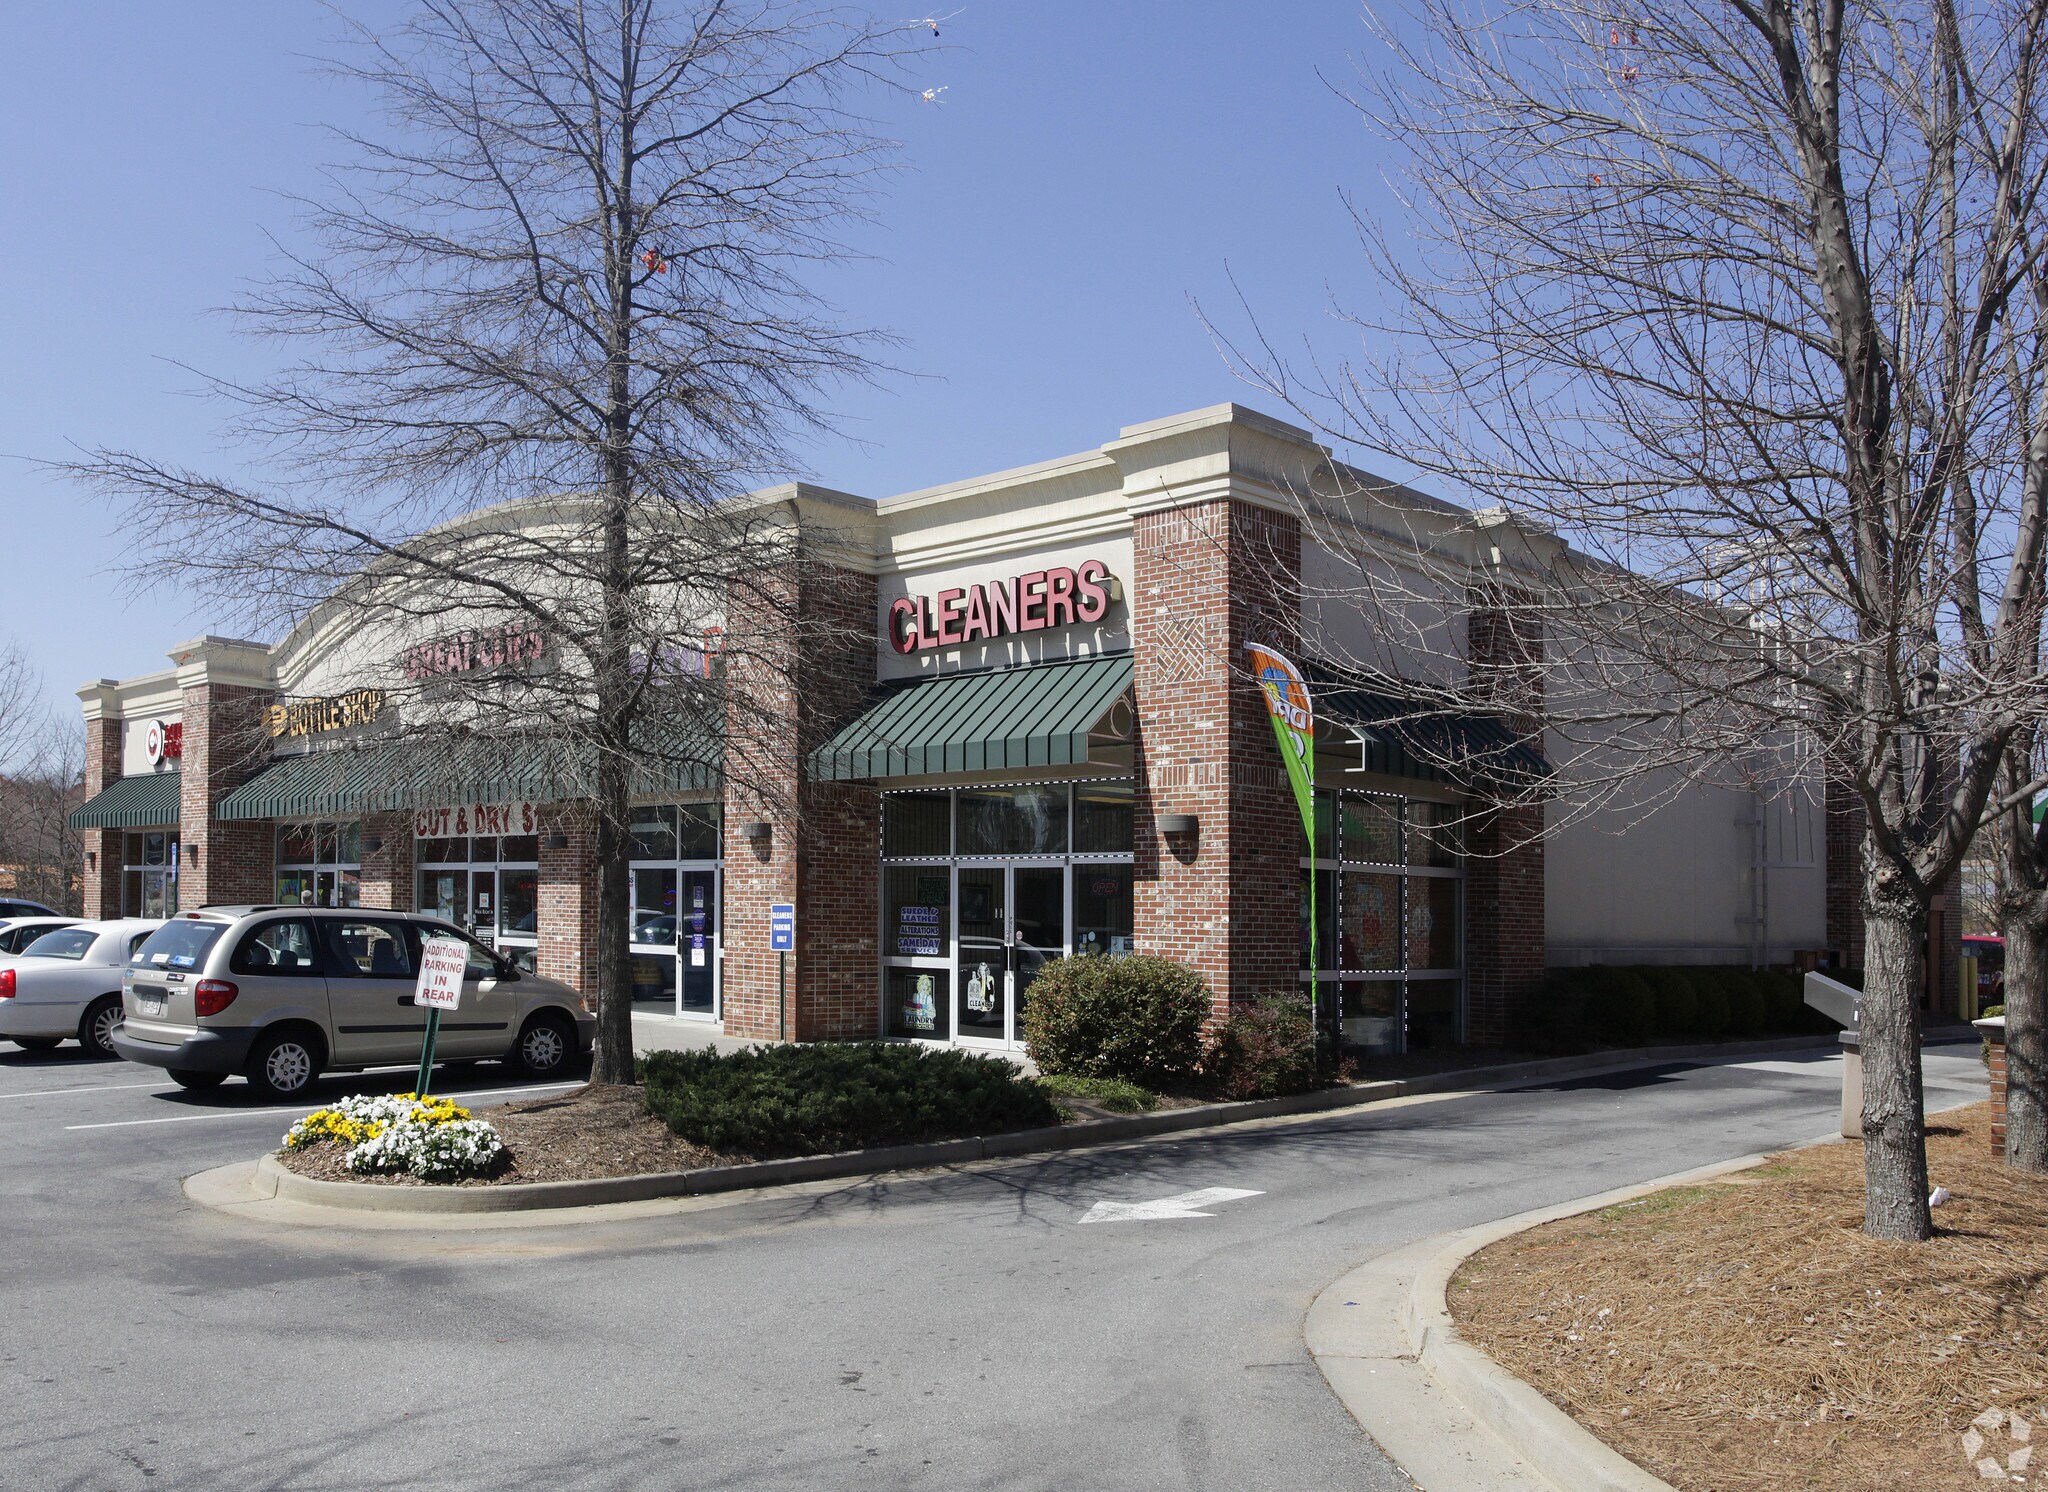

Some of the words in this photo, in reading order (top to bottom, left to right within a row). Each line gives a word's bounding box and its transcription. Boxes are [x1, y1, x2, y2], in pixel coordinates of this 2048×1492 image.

[889, 559, 1109, 654] CLEANERS
[289, 698, 340, 736] BOTTLE
[343, 690, 381, 727] SHOP
[416, 808, 450, 836] CUT
[456, 806, 469, 834] &
[474, 804, 511, 834] DRY
[772, 911, 793, 919] CLEANERS
[901, 907, 929, 915] SUEDE
[930, 907, 939, 916] &
[901, 915, 939, 923] LEATHER
[773, 923, 791, 931] PARKING
[900, 926, 939, 935] ALTERATIONS
[898, 937, 921, 948] SAME
[922, 938, 940, 949] DAY
[426, 945, 465, 960] ADDITIONAL
[424, 959, 462, 974] PARKING
[434, 975, 448, 986] IN
[422, 988, 454, 1002] REAR
[905, 1016, 934, 1024] LAUNDRY
